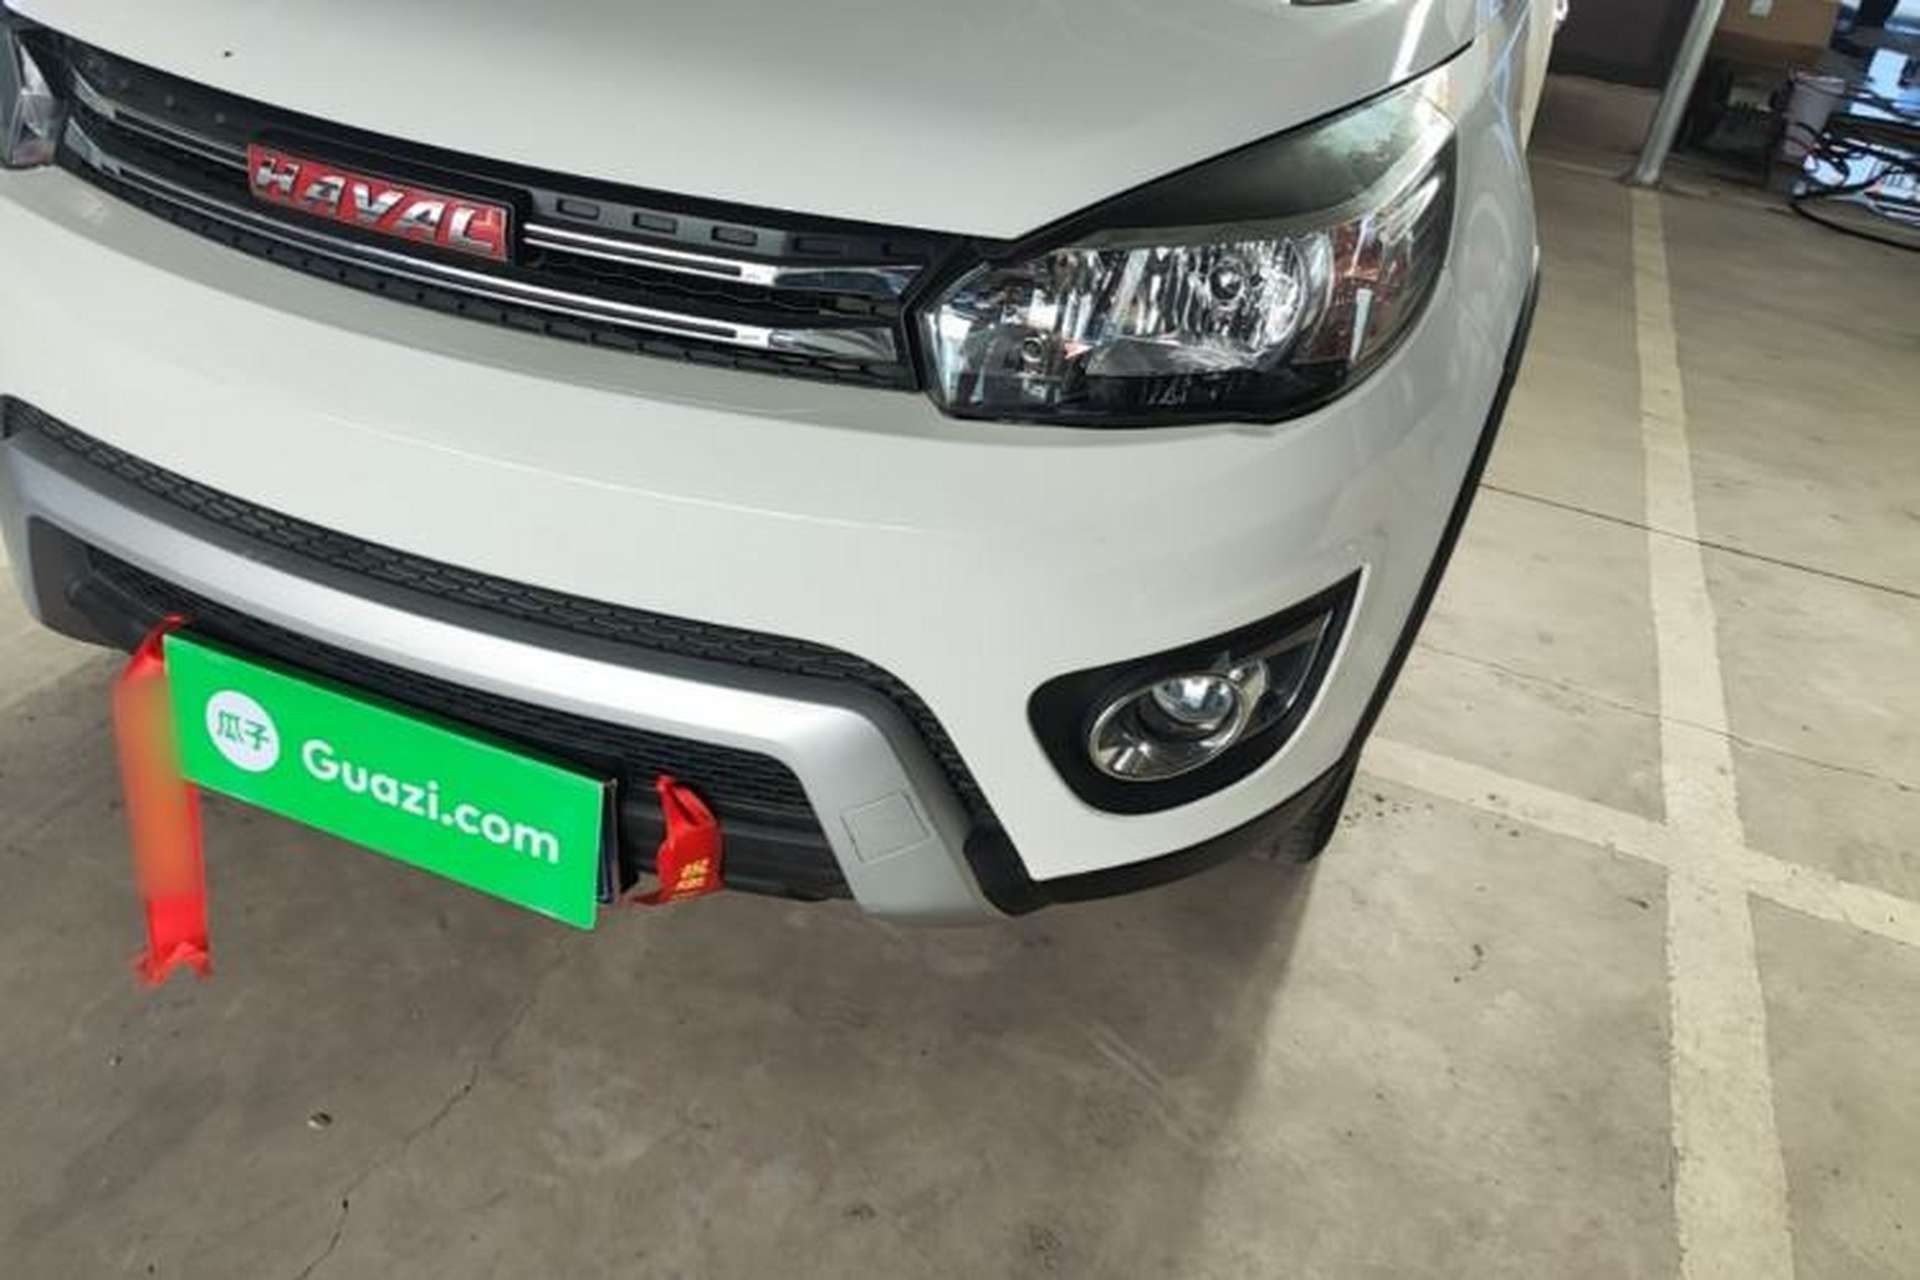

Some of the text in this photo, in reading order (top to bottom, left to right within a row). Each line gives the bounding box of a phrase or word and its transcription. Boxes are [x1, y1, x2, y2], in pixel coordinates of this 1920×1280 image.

[255, 157, 494, 253] HAVAL
[216, 709, 270, 751] 瓜子
[302, 739, 560, 864] Guazi.com
